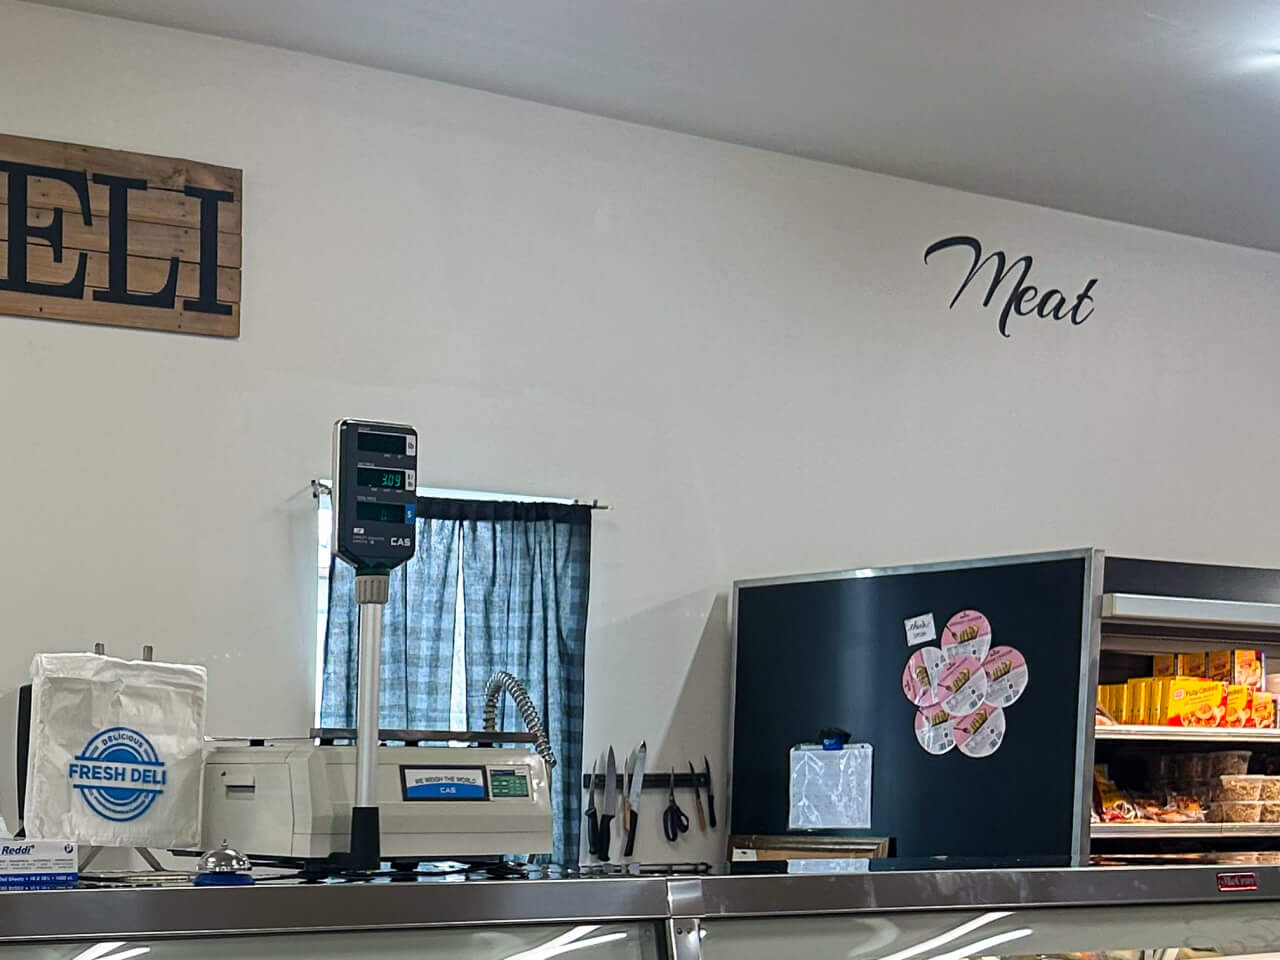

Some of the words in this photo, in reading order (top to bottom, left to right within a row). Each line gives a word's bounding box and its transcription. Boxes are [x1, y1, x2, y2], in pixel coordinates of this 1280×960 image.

[924, 236, 1098, 338] Meat
[390, 537, 411, 546] CAS
[102, 733, 144, 748] DELICIOUS
[69, 763, 126, 782] FRESH
[131, 767, 166, 785] DELI
[1, 845, 31, 856] Reddi
